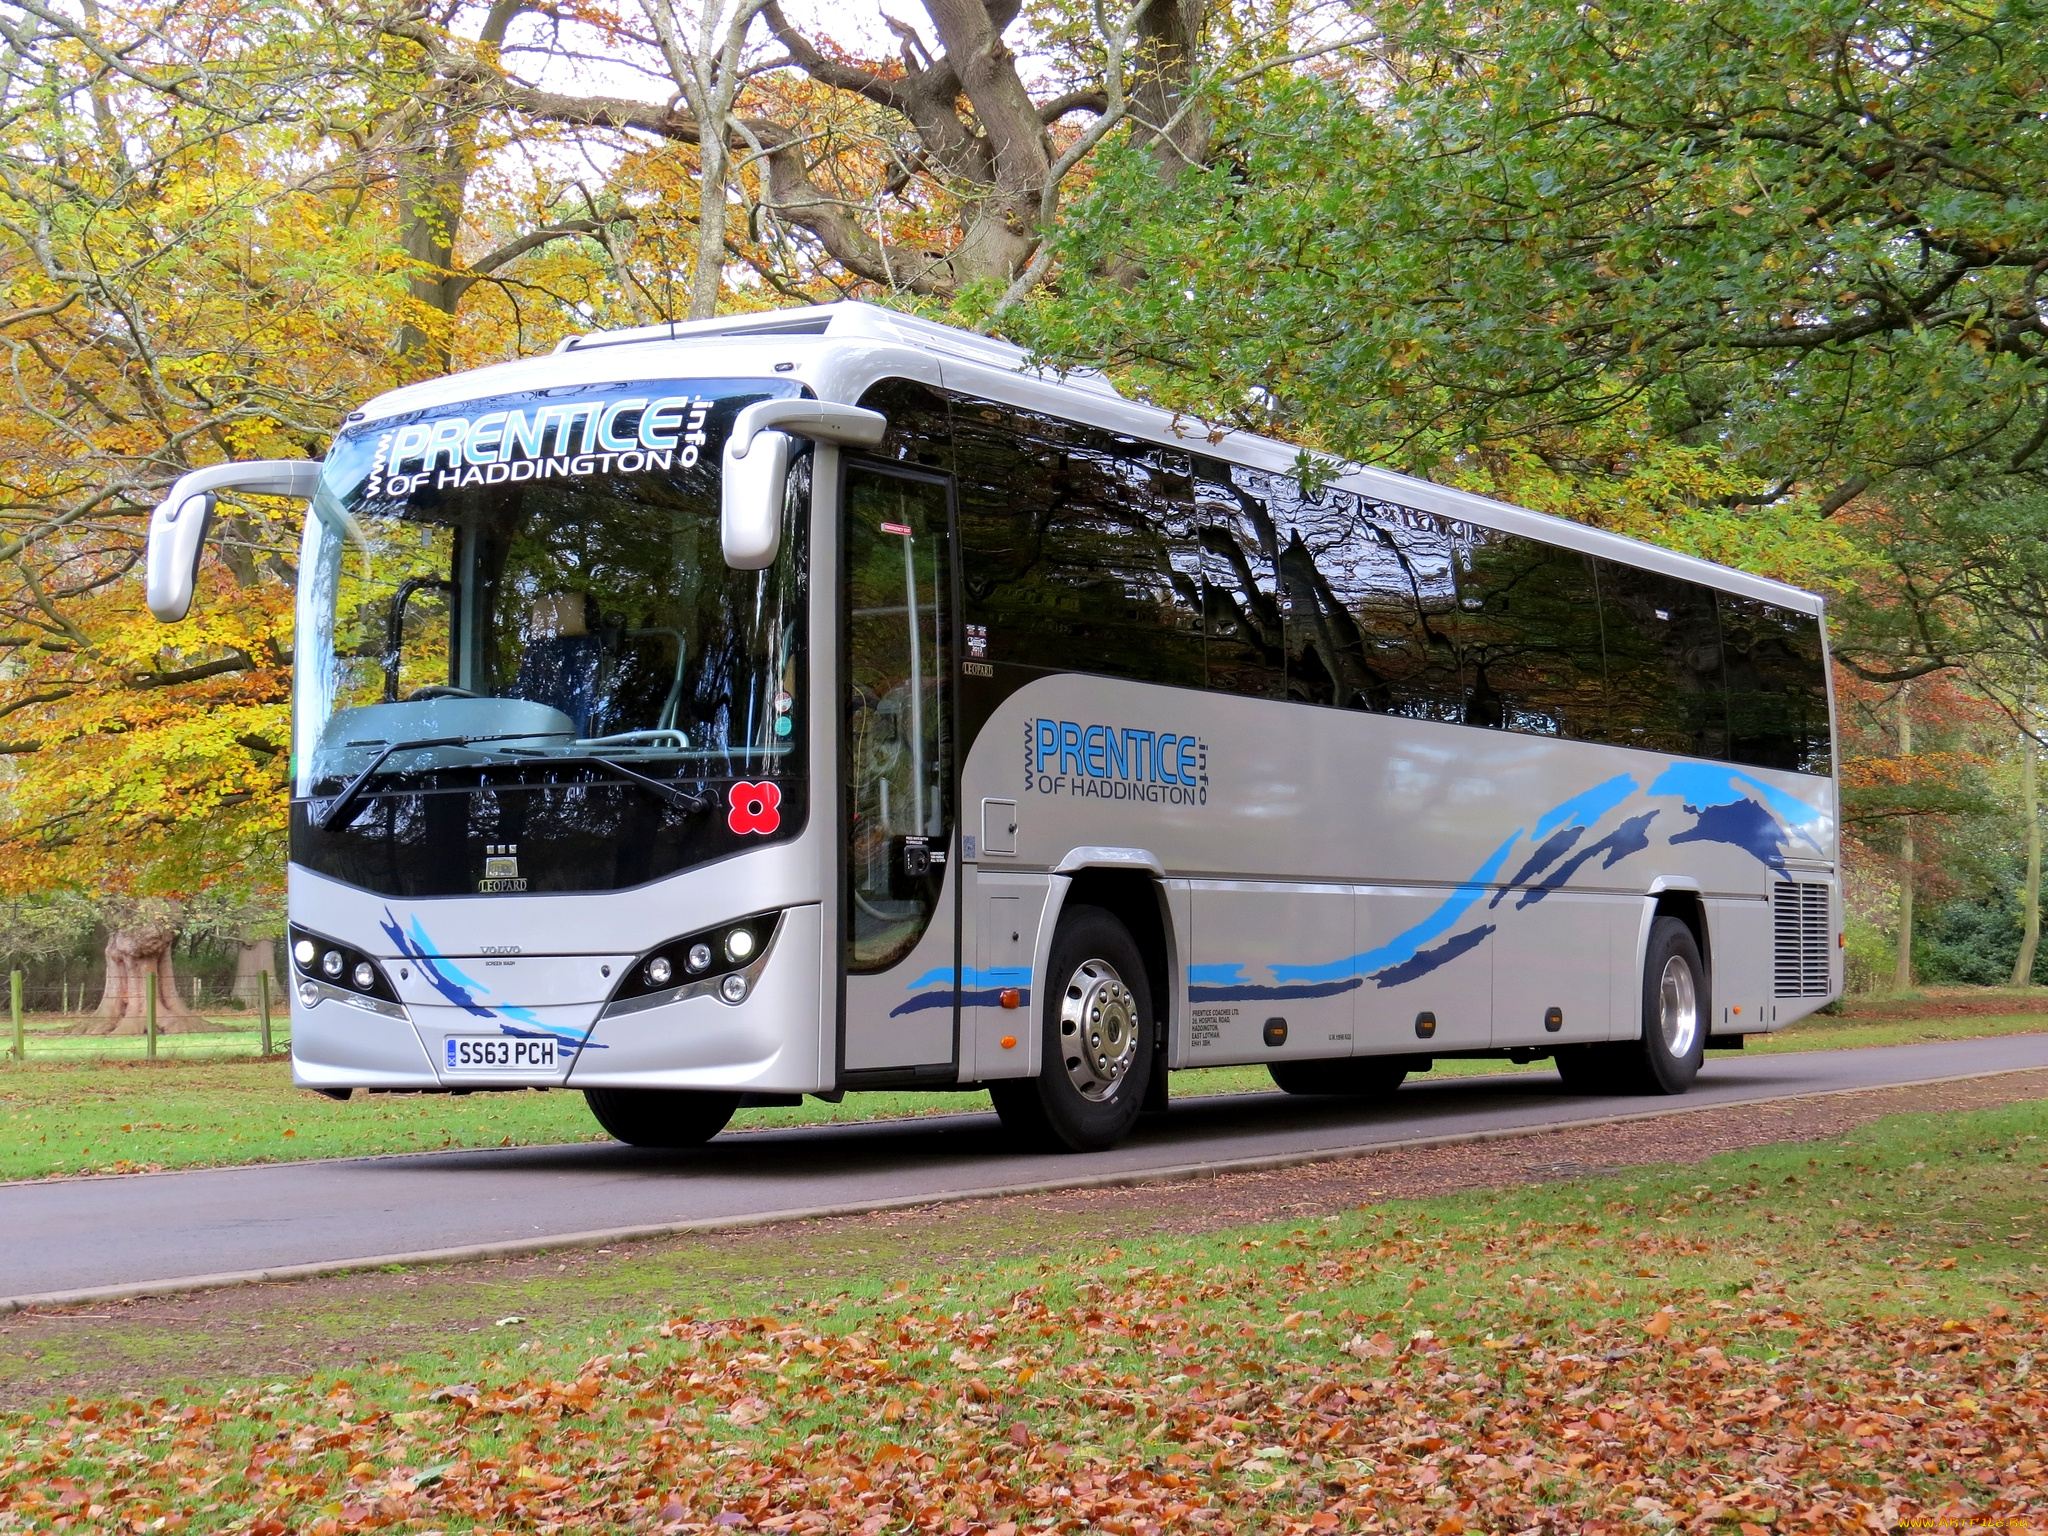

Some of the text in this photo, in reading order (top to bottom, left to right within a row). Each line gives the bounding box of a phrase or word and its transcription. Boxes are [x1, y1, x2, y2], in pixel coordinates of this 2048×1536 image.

[387, 396, 689, 477] PRENTICE
[387, 449, 673, 496] OF HADDINGTON
[963, 662, 994, 678] LEOPARD
[1036, 718, 1197, 787] PRENTICE
[1038, 775, 1195, 806] OF HADDINGTON
[480, 879, 528, 892] LEOPARD
[480, 945, 521, 954] VOLVO
[460, 1041, 554, 1065] SS63 PCH
